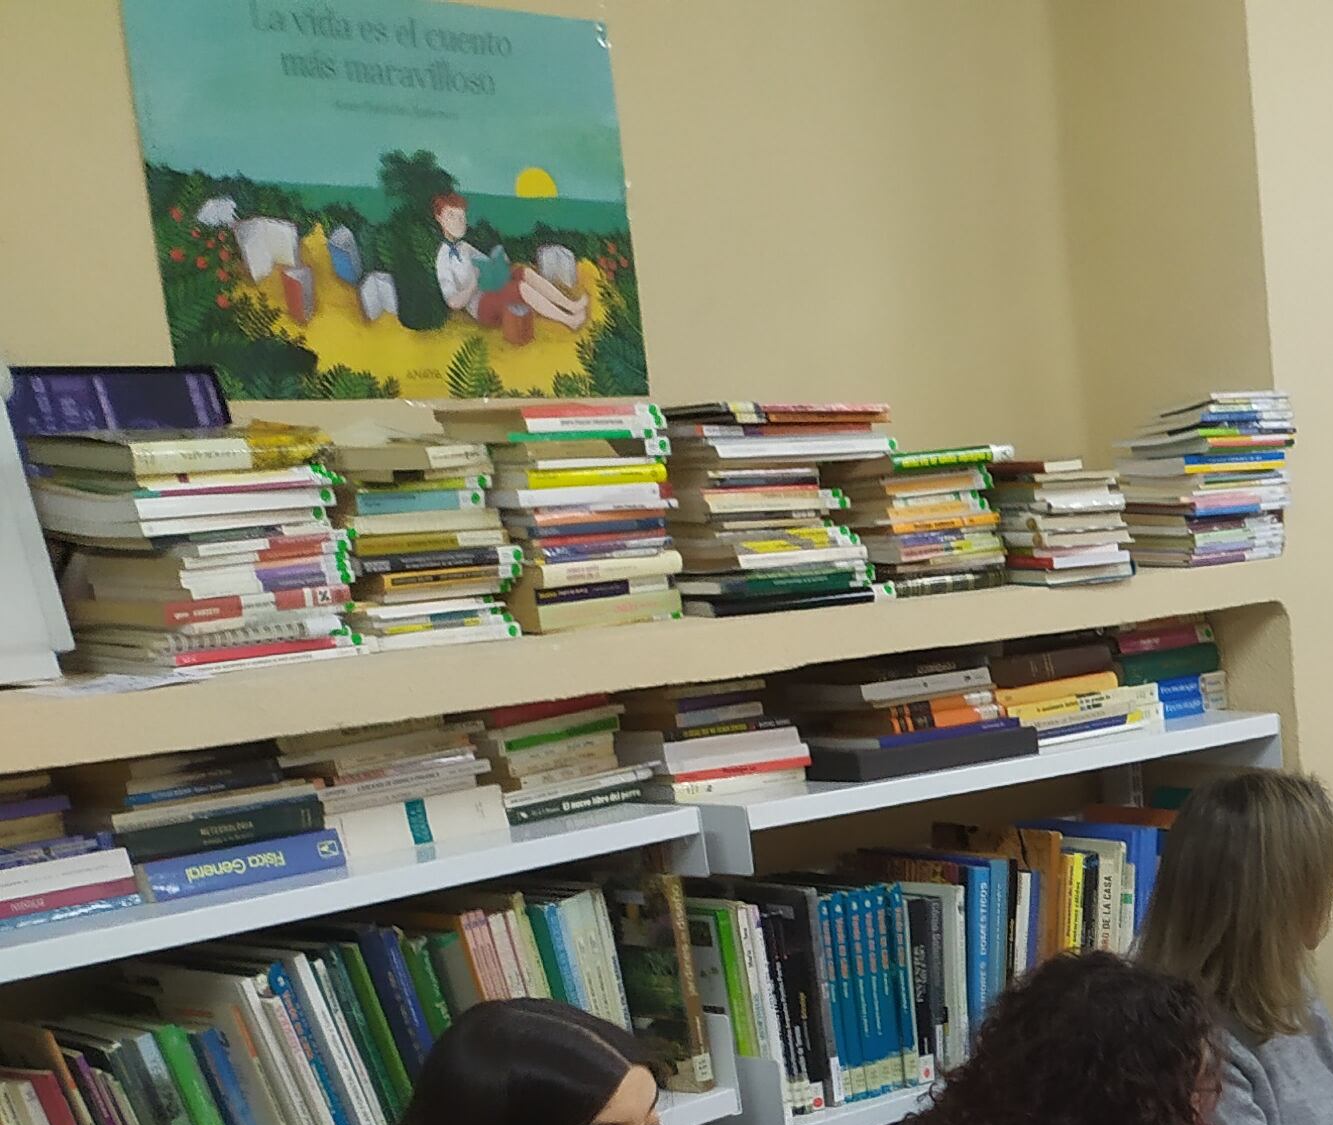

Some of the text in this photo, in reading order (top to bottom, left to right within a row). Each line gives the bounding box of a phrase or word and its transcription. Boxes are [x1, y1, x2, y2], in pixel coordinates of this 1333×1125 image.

[249, 0, 512, 57] La vida es el cuento
[280, 50, 496, 96] más maravilloso
[185, 850, 287, 884] Física General
